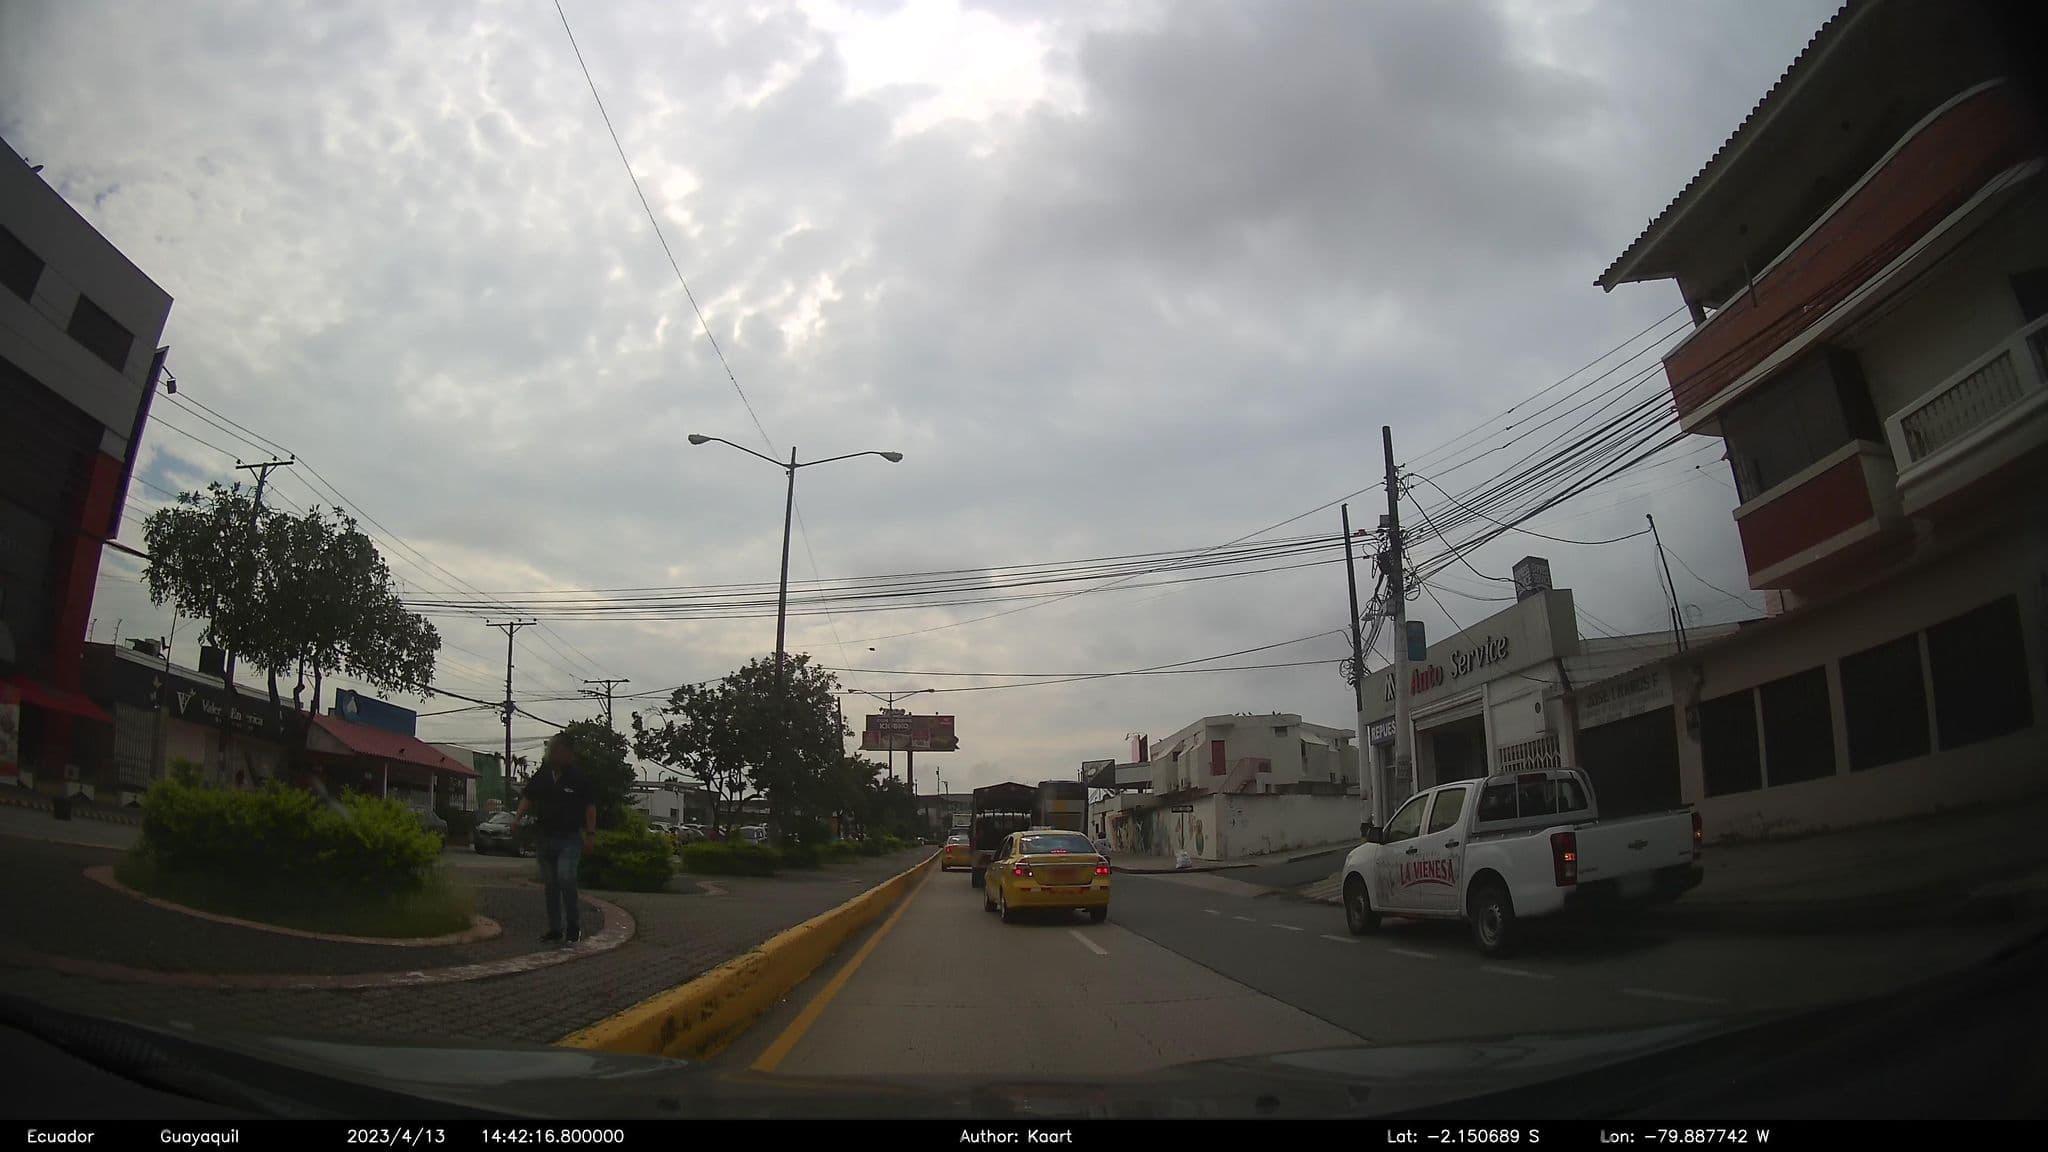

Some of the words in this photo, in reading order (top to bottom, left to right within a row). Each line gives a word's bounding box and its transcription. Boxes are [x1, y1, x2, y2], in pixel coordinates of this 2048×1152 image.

[1410, 665, 1444, 696] Auto
[1449, 636, 1509, 679] Service
[1371, 720, 1397, 742] REPUES
[1400, 862, 1411, 886] LA
[1412, 858, 1456, 885] VIENESA
